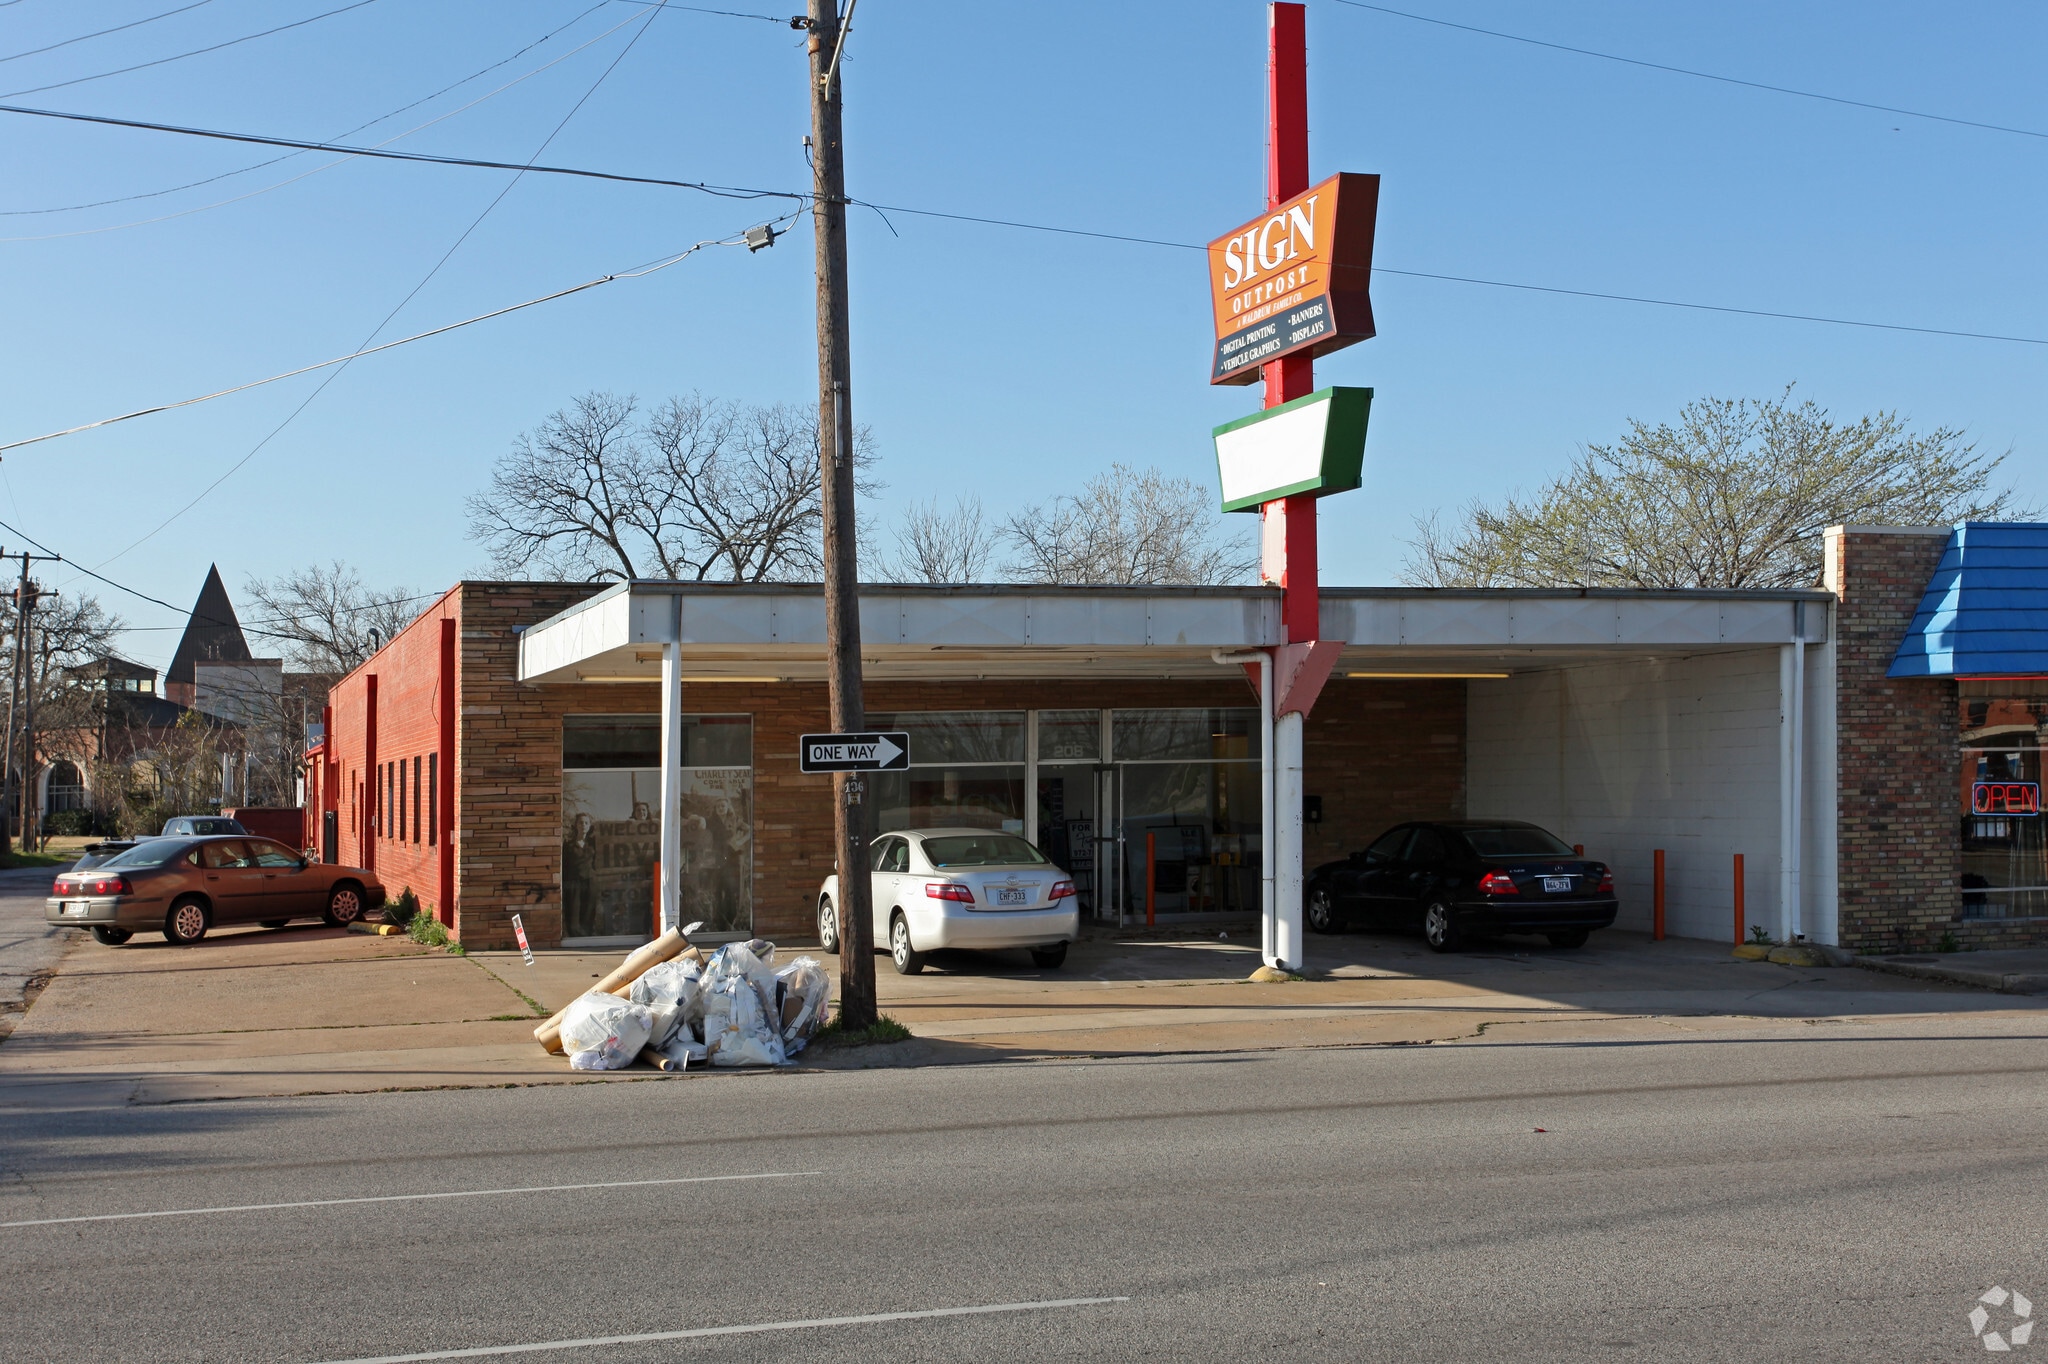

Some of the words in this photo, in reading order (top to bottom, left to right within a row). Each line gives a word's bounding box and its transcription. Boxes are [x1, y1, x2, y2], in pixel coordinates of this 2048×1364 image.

[1224, 194, 1318, 292] SIGN
[1233, 266, 1308, 314] OUTPOST
[1236, 319, 1241, 329] A
[1273, 295, 1293, 312] FAMILY
[1291, 303, 1323, 326] BANNERS
[1223, 335, 1246, 355] DIGITAL
[1246, 323, 1276, 345] PRINTING
[1292, 320, 1324, 344] DISPLAYS
[1223, 351, 1249, 371] VEHICLE
[1249, 338, 1281, 361] GRAPHICS
[813, 746, 842, 761] ONE
[847, 744, 877, 760] WAY
[1054, 745, 1084, 758] 208
[844, 780, 864, 793] 136
[1975, 785, 2037, 813] OPEN
[1072, 824, 1091, 832] FOR
